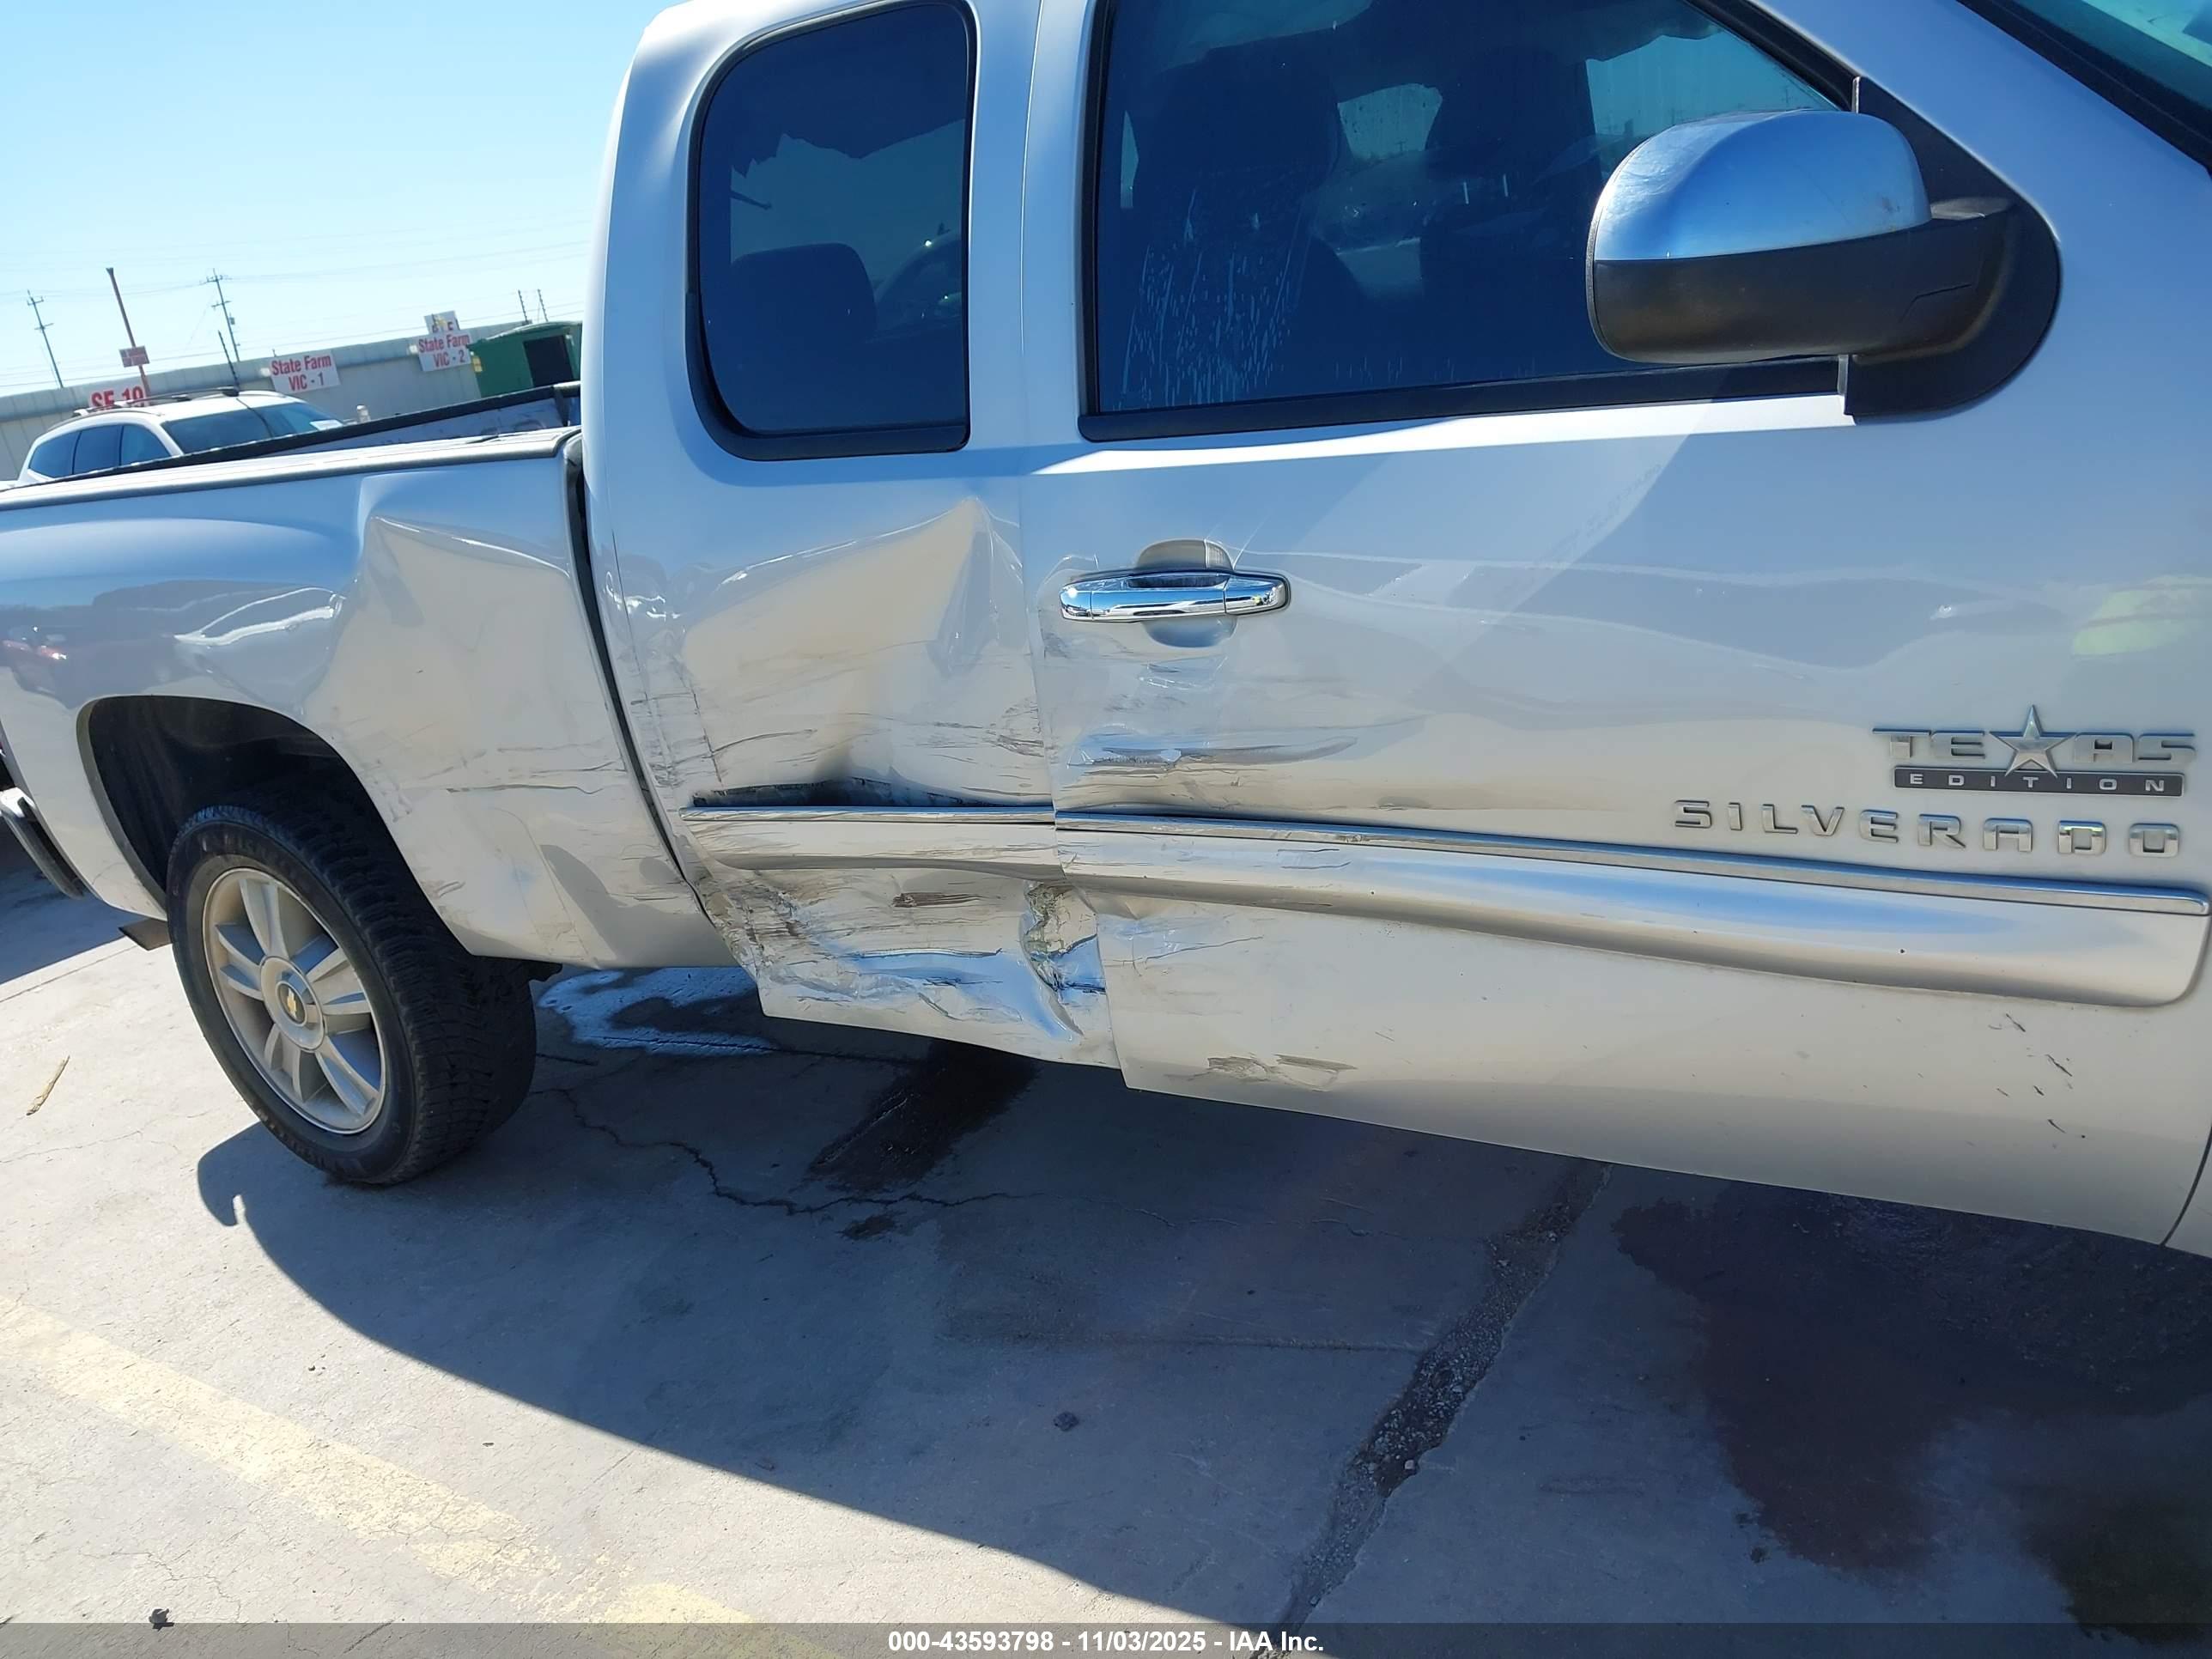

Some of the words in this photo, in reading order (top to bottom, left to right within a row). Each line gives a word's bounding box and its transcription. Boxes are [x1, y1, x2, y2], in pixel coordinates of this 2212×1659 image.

[418, 337, 444, 353] State
[446, 333, 471, 349] Farm
[271, 358, 301, 376] State
[303, 355, 332, 371] Farm
[433, 351, 450, 368] VIC
[459, 349, 465, 363] 2
[289, 374, 307, 392] VIC
[318, 372, 325, 386] 1
[1909, 773, 2165, 793] EDITION
[1674, 799, 2180, 858] SILVERADO
